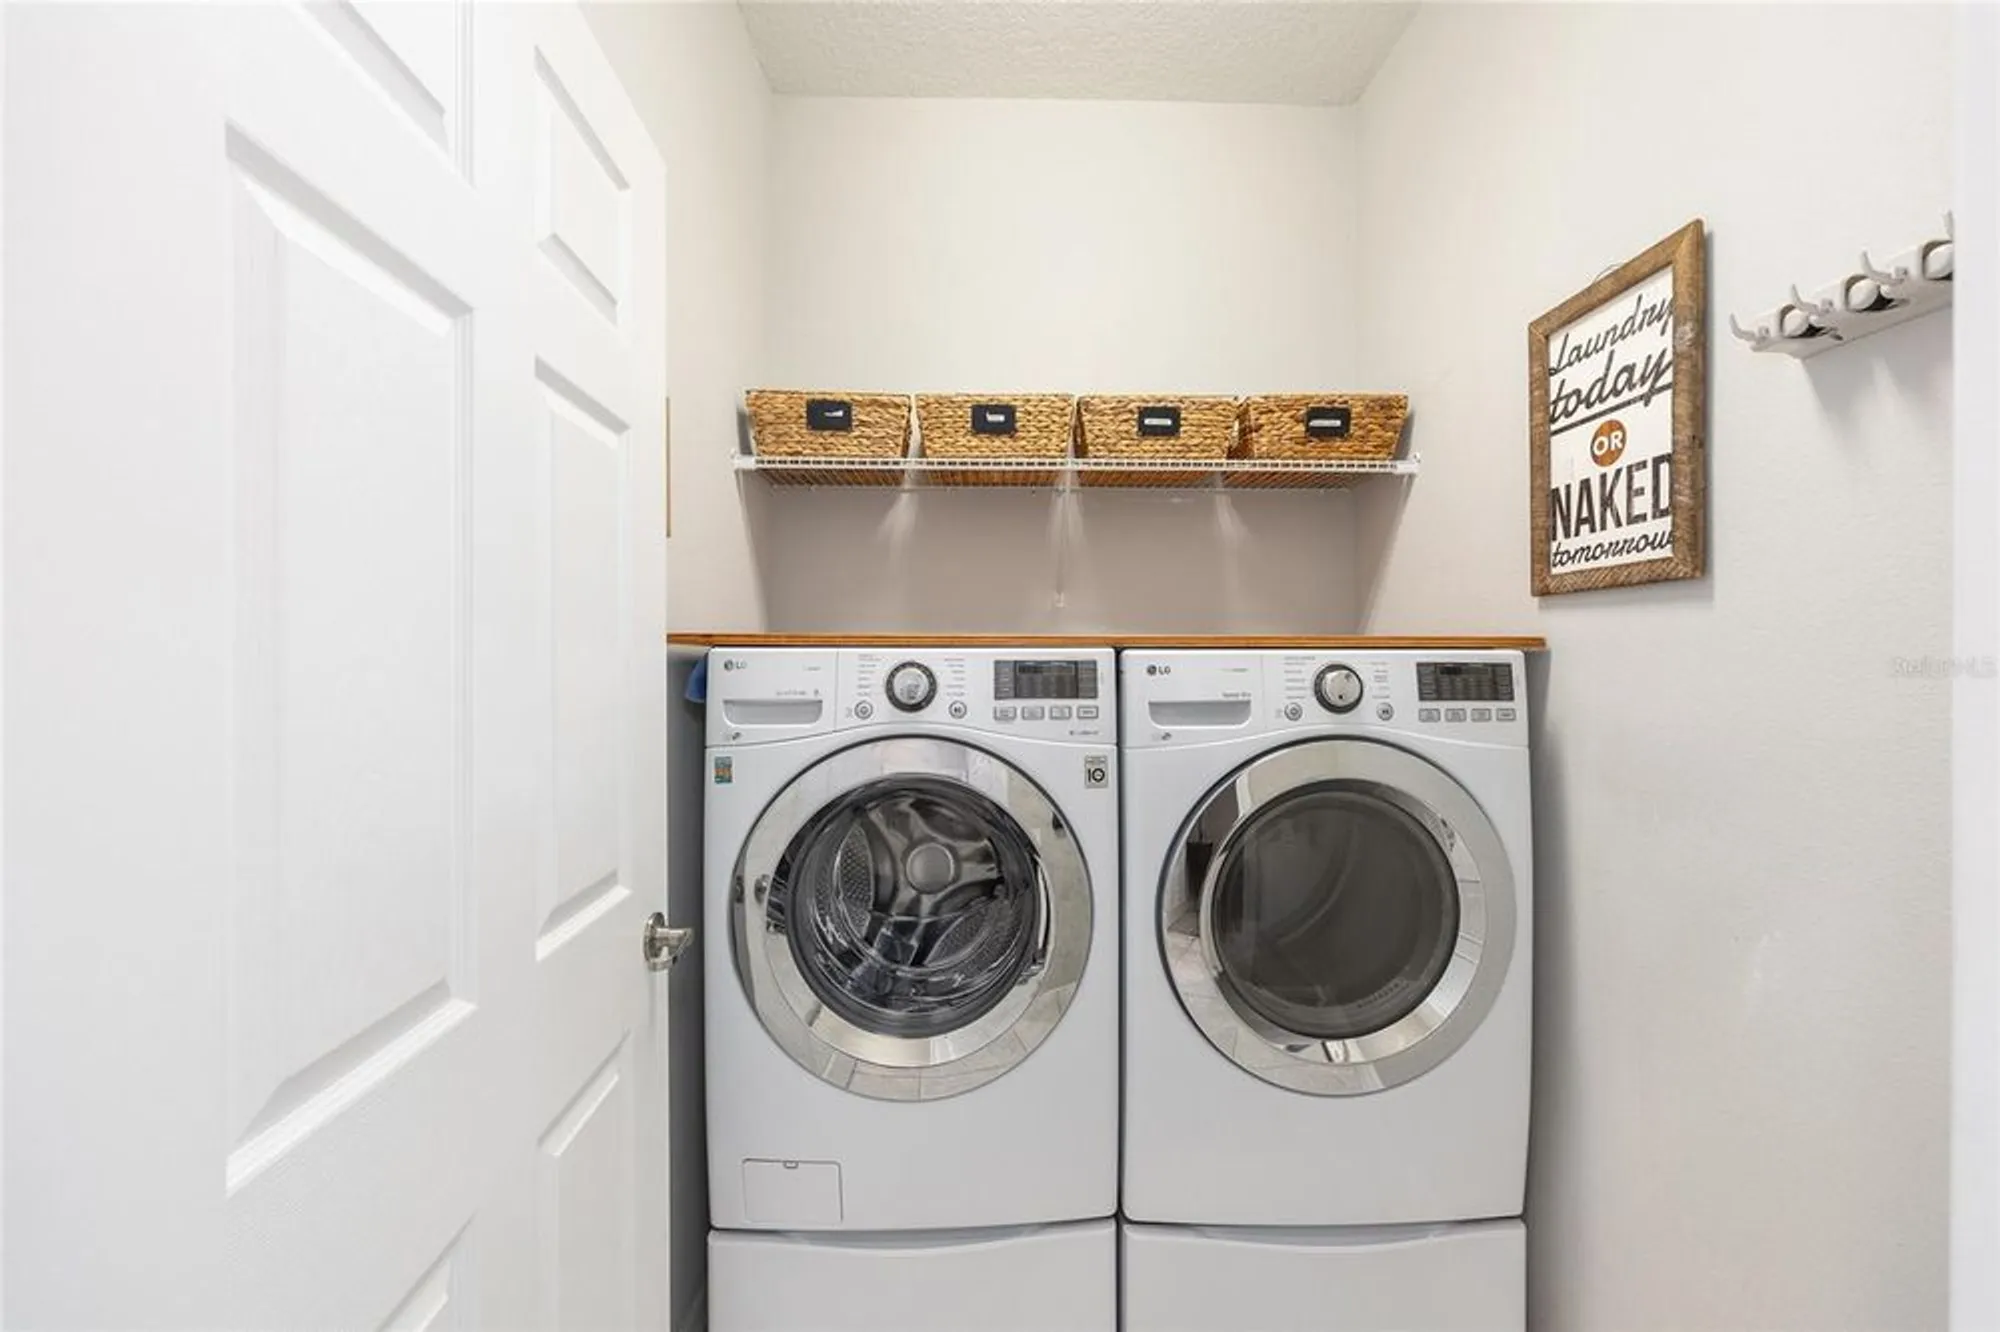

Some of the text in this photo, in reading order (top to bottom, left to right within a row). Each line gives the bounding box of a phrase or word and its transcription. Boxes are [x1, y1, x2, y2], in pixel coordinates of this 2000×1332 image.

[1549, 294, 1673, 377] Laundry
[1550, 348, 1673, 424] today
[1593, 431, 1624, 456] OR
[1551, 453, 1673, 541] NAKED
[1552, 530, 1673, 567] tomorrow
